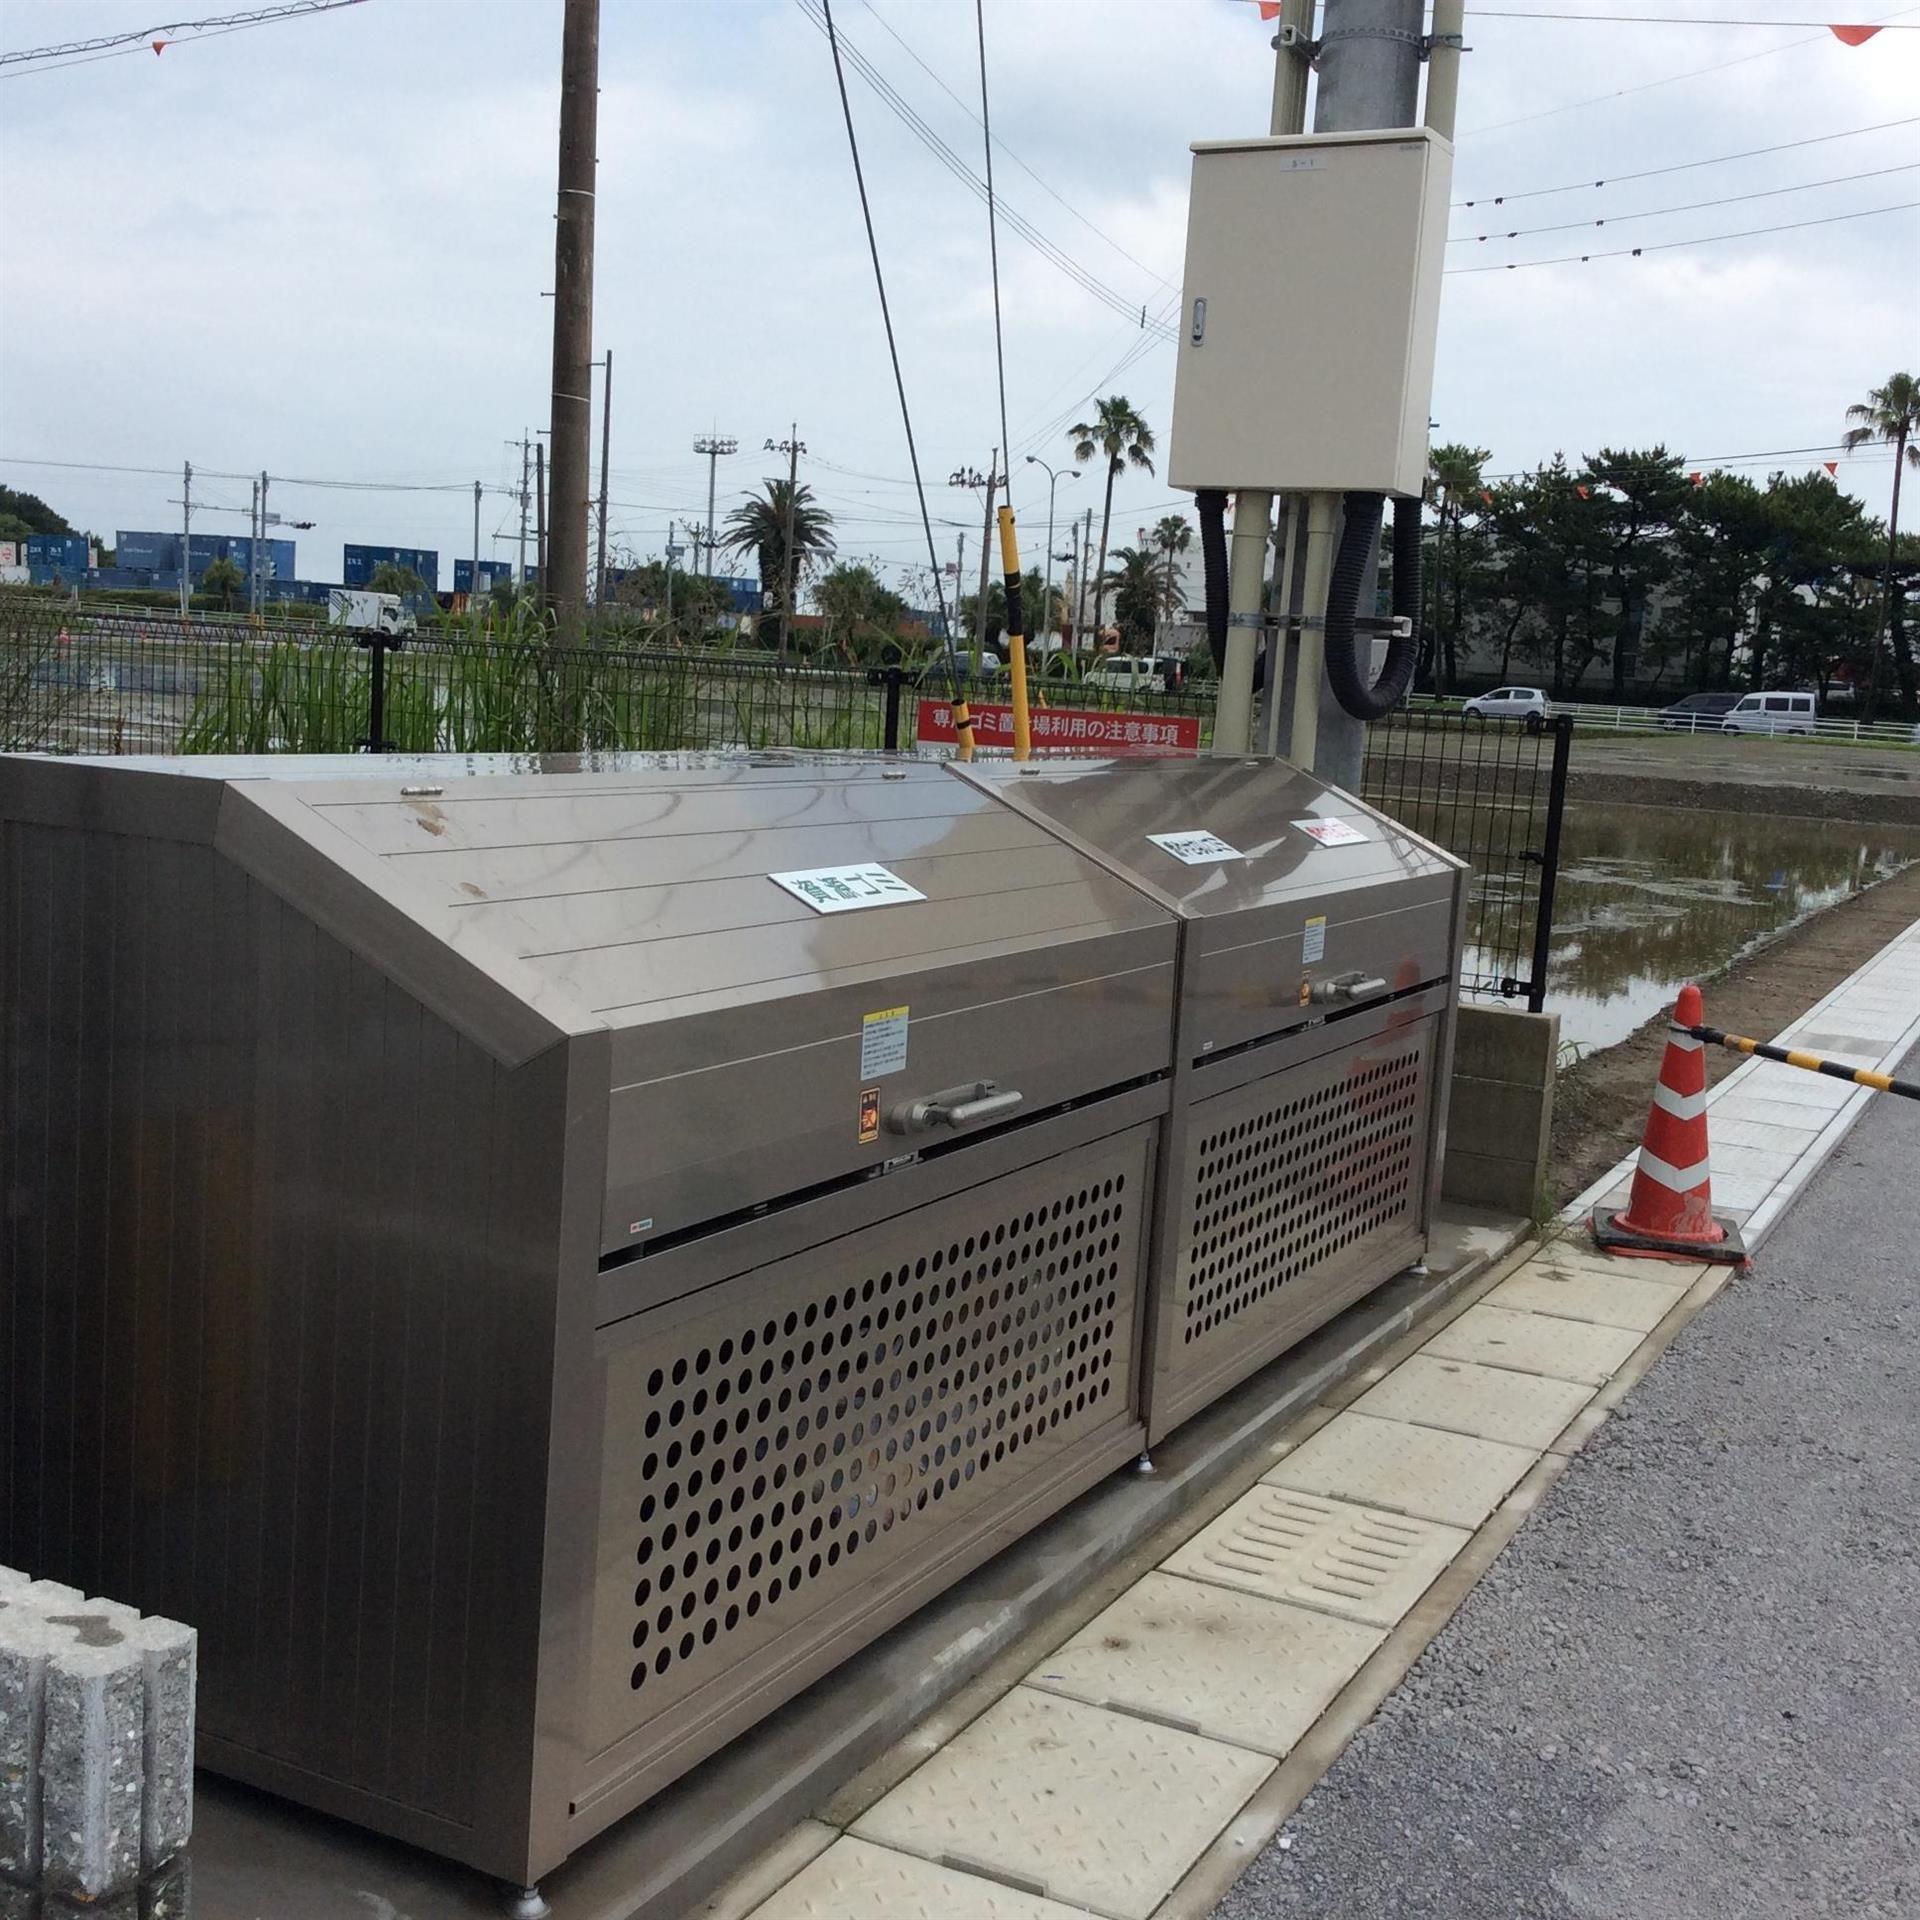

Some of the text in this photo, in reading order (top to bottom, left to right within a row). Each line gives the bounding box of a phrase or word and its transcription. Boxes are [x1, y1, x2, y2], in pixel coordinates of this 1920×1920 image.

[932, 708, 1179, 745] 専ゴミ置場利用の注意事項
[790, 872, 908, 904] 資源ゴミ
